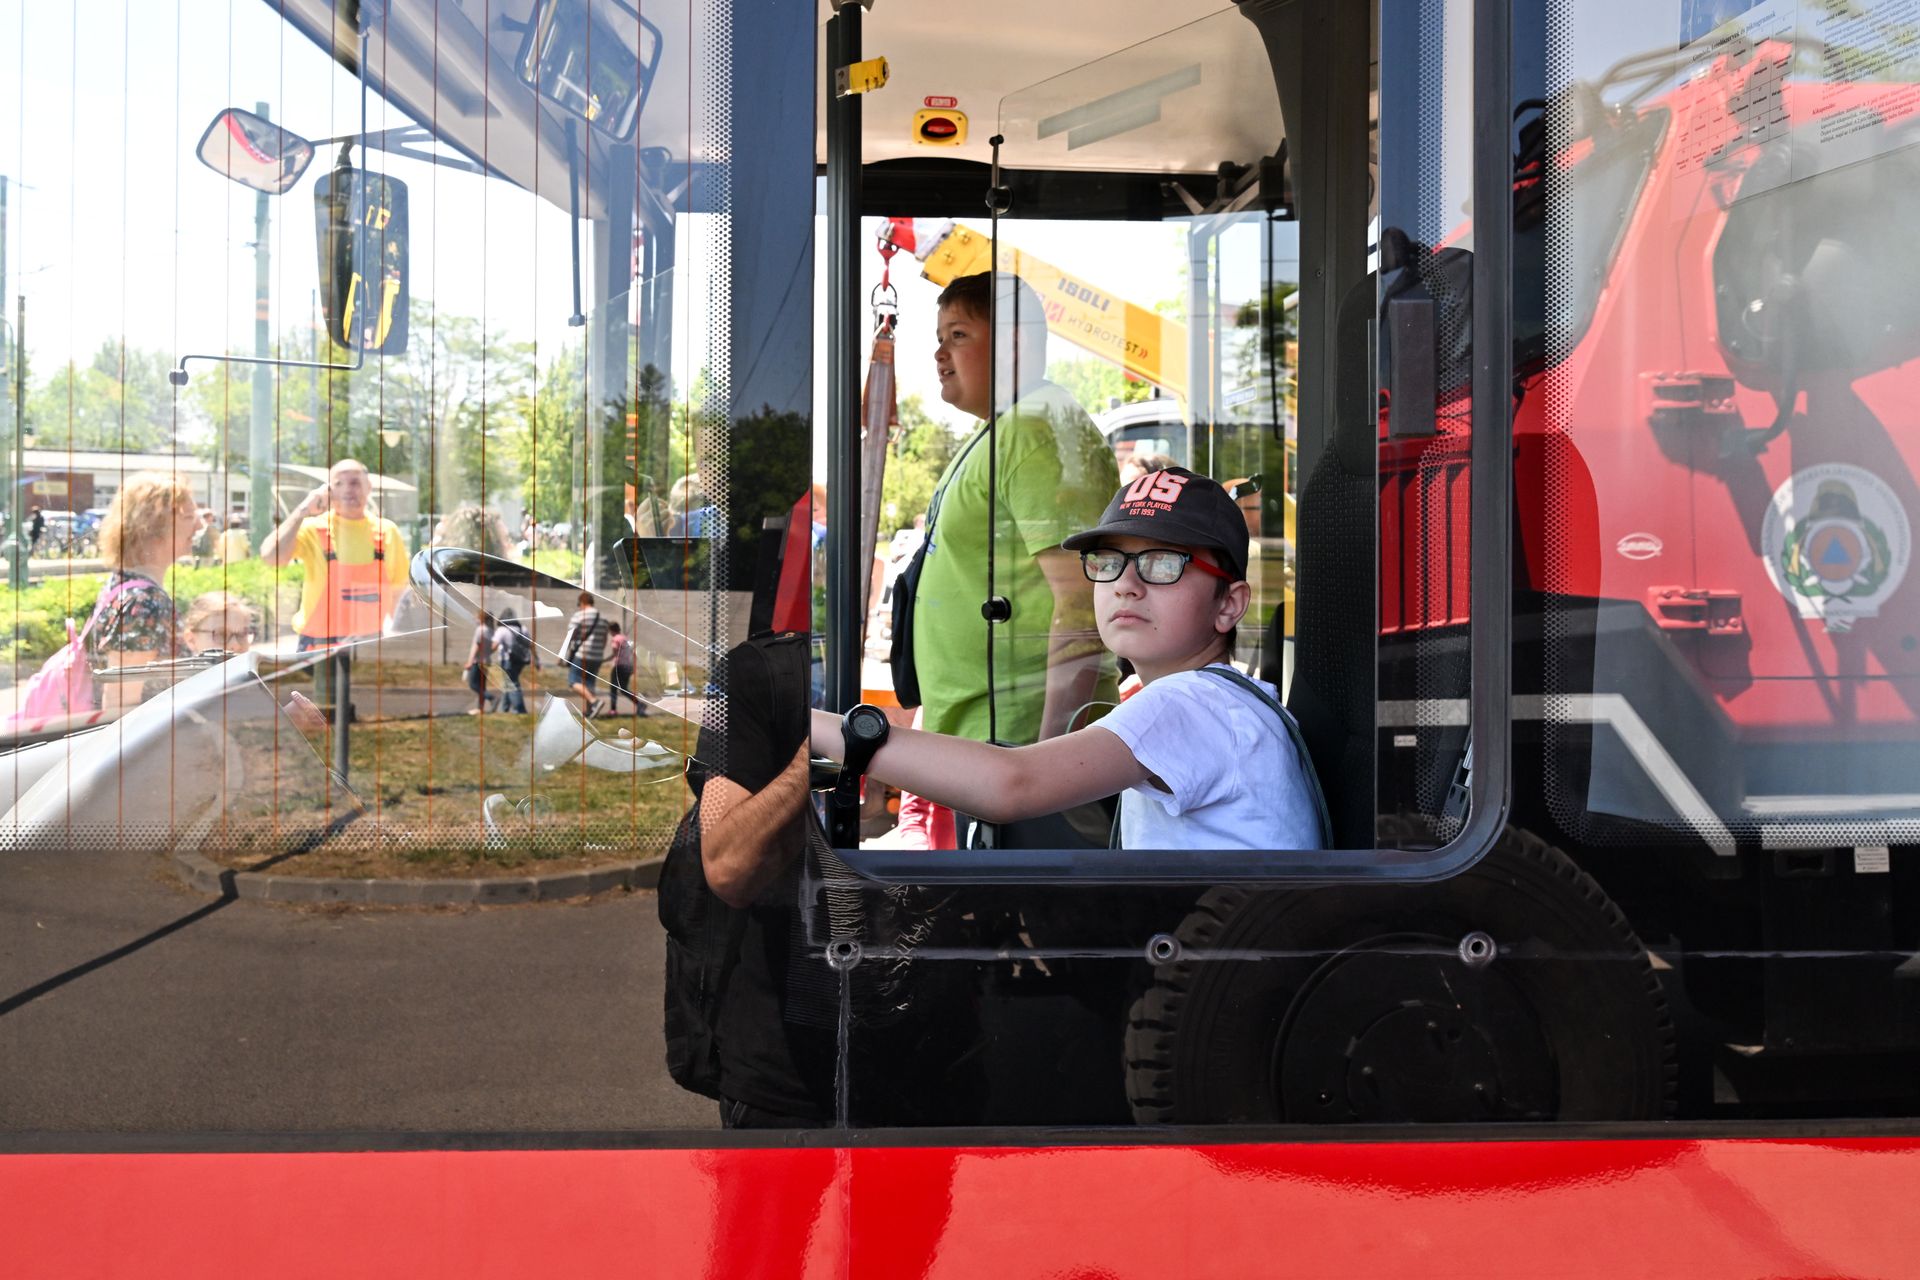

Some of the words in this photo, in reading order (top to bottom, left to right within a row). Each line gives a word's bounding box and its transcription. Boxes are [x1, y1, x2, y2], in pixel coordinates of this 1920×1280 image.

[1057, 277, 1110, 312] ISOLI
[1068, 315, 1139, 354] HYDROTEST
[1147, 501, 1172, 512] PLAYERS
